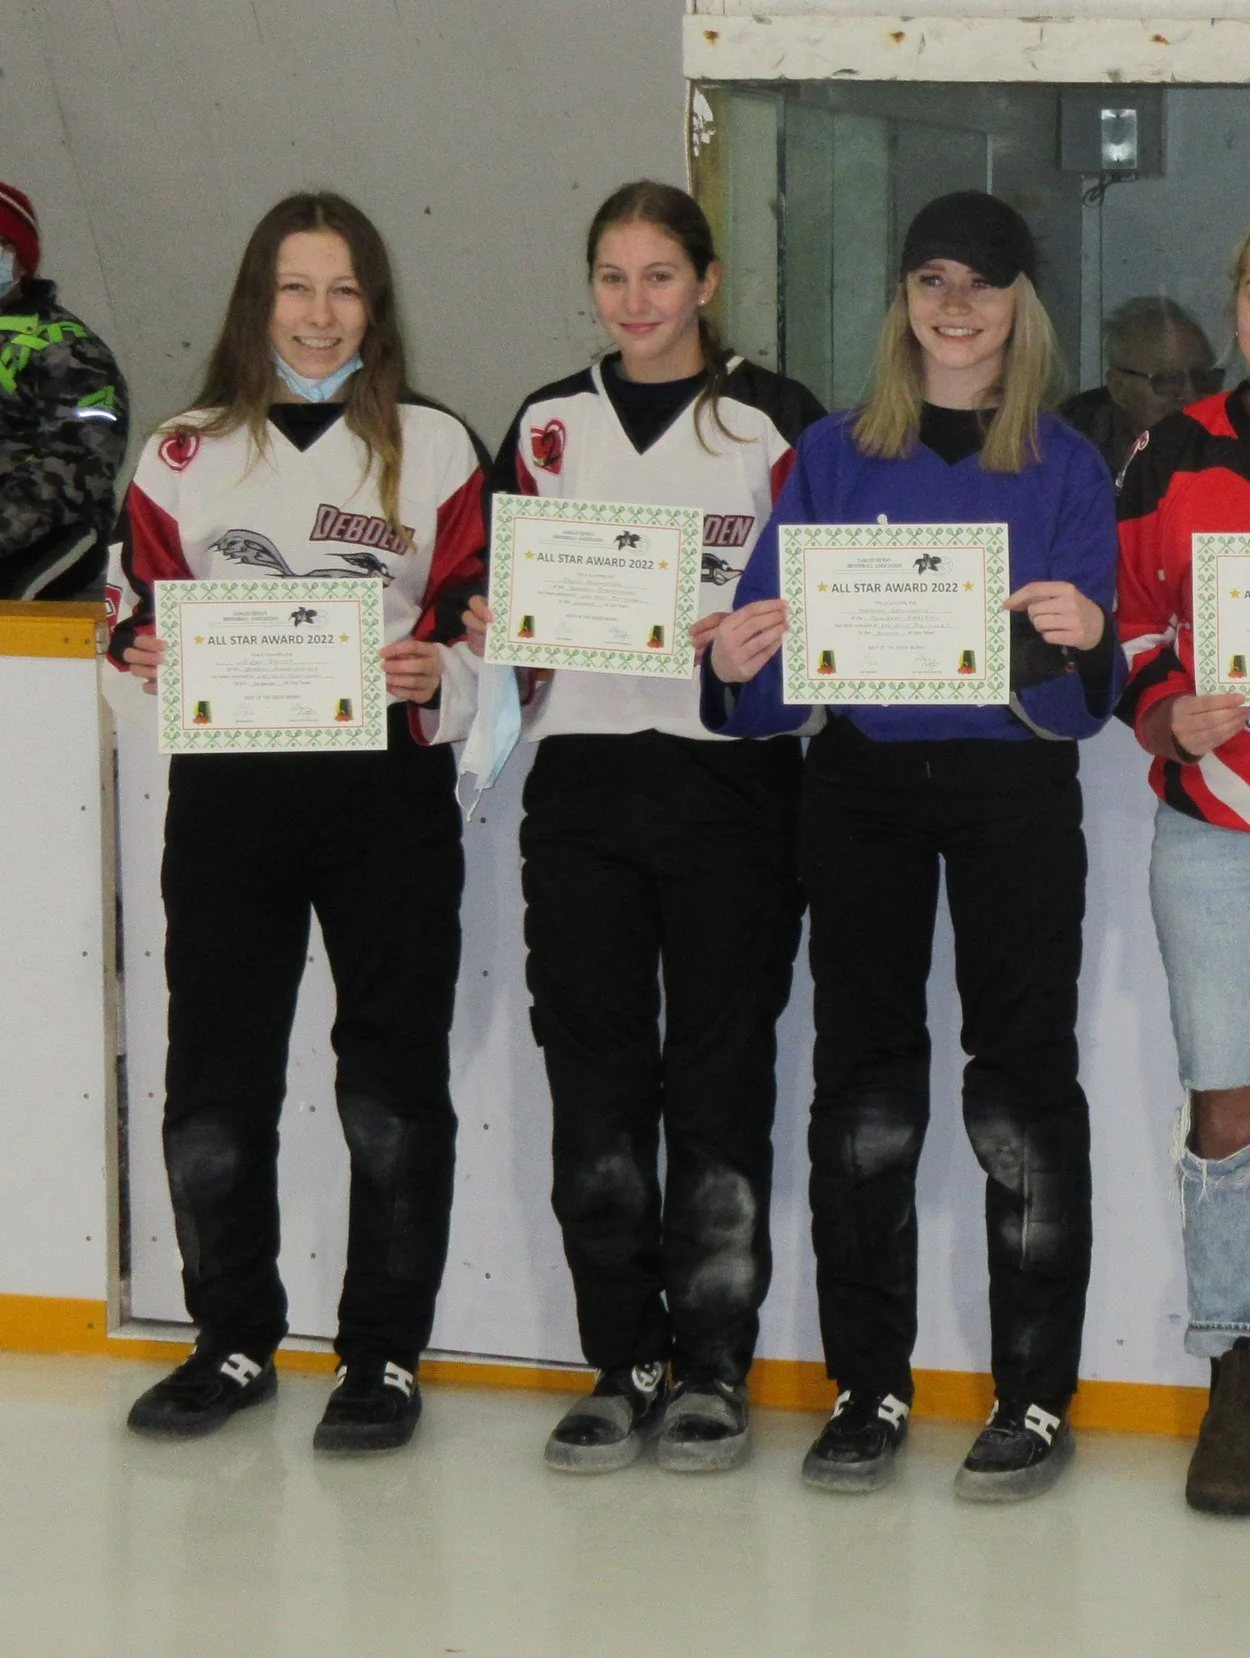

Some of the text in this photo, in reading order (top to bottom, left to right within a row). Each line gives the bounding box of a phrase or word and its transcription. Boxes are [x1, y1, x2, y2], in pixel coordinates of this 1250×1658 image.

[702, 514, 755, 547] DEN
[537, 552, 654, 570] ALL STAR AWARD 2022
[832, 582, 958, 593] ALL STAR AWARD 2022
[208, 634, 334, 645] ALL STAR AWARD 2022
